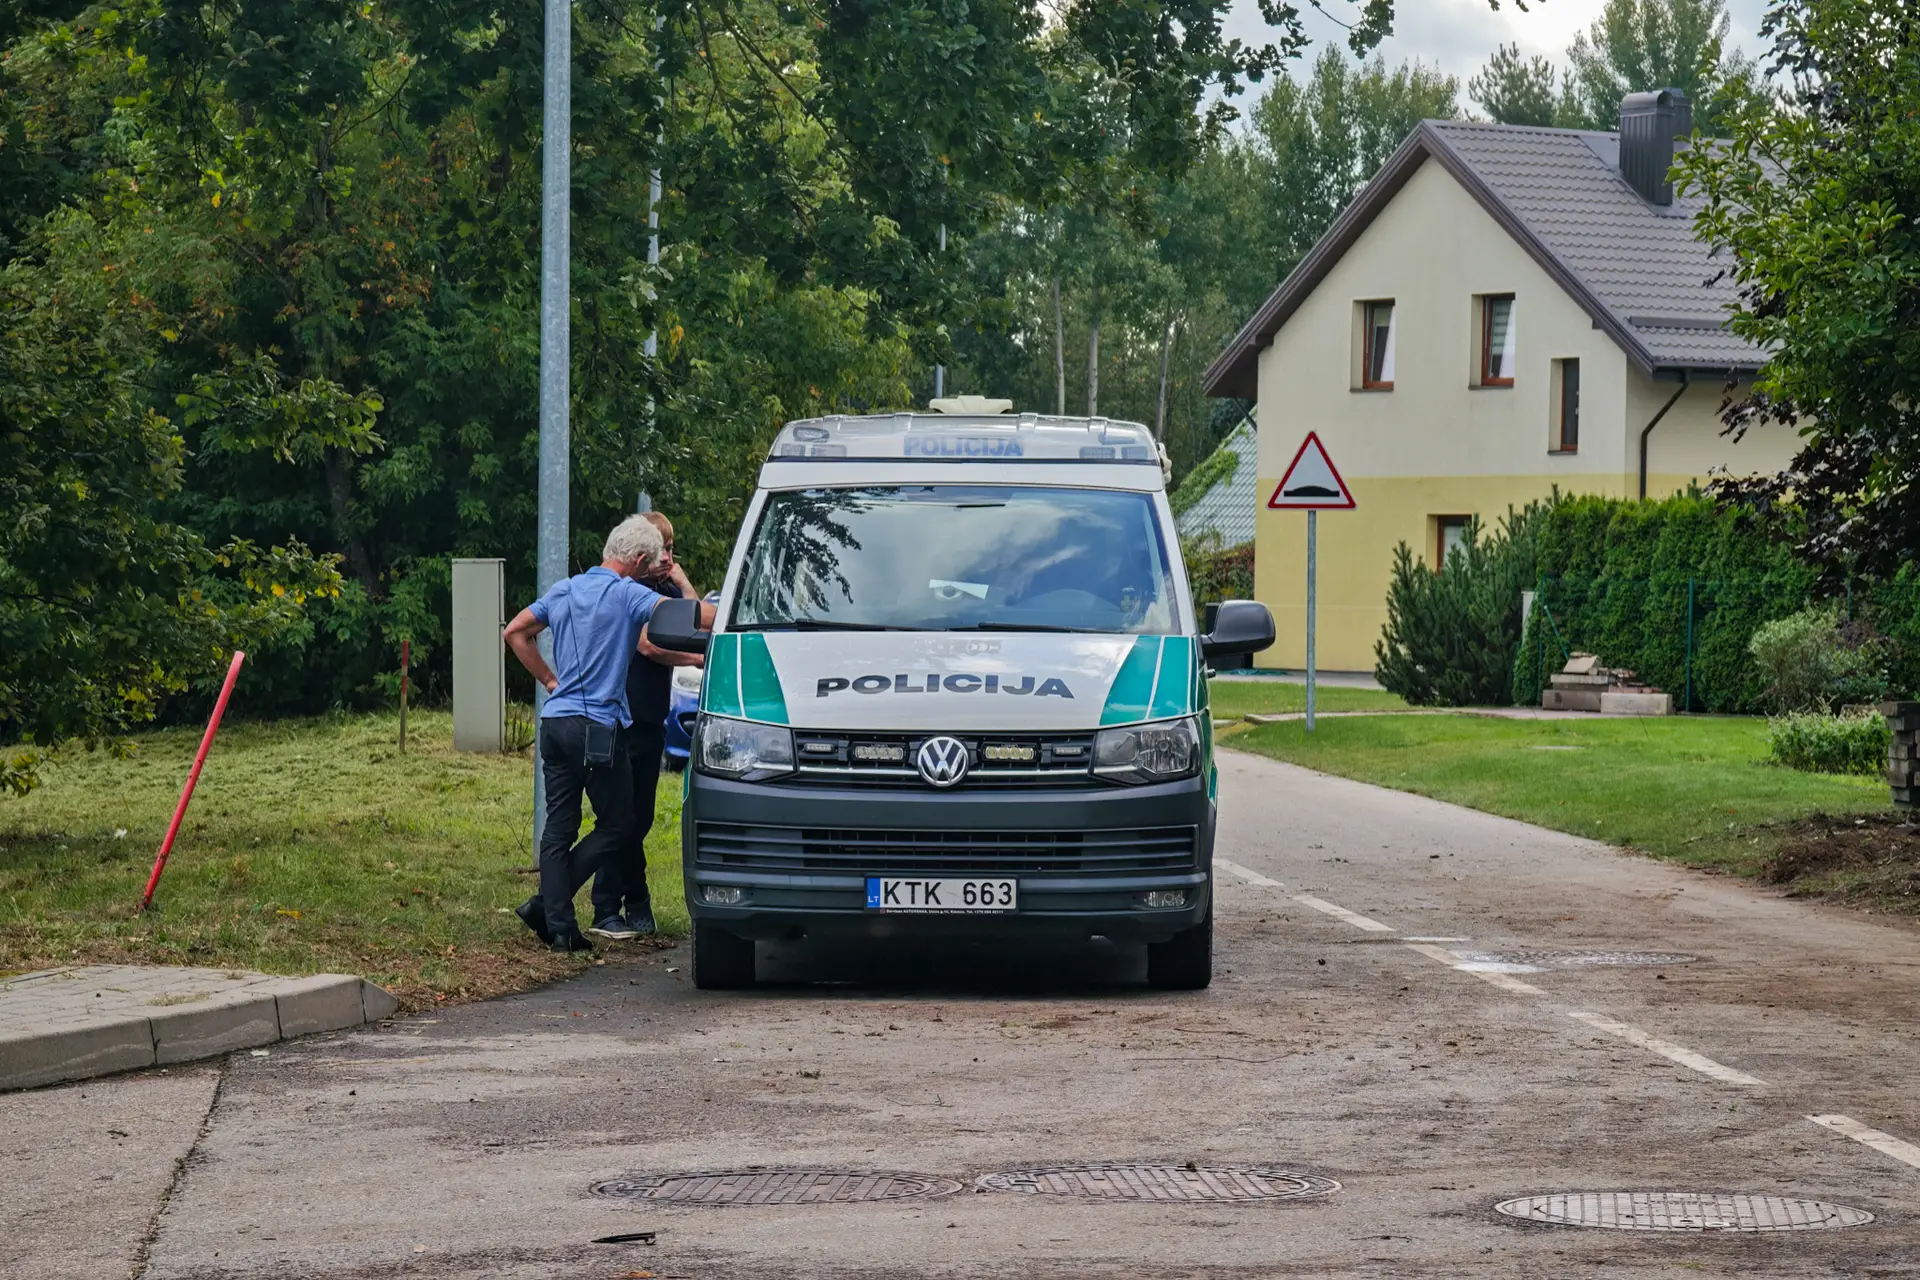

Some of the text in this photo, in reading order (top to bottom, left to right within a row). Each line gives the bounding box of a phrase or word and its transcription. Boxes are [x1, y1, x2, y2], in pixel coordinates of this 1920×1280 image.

[904, 437, 1023, 456] POLICIJA
[816, 674, 1075, 699] POLICIJA
[868, 895, 879, 903] LT
[883, 881, 1012, 906] KTK 663
